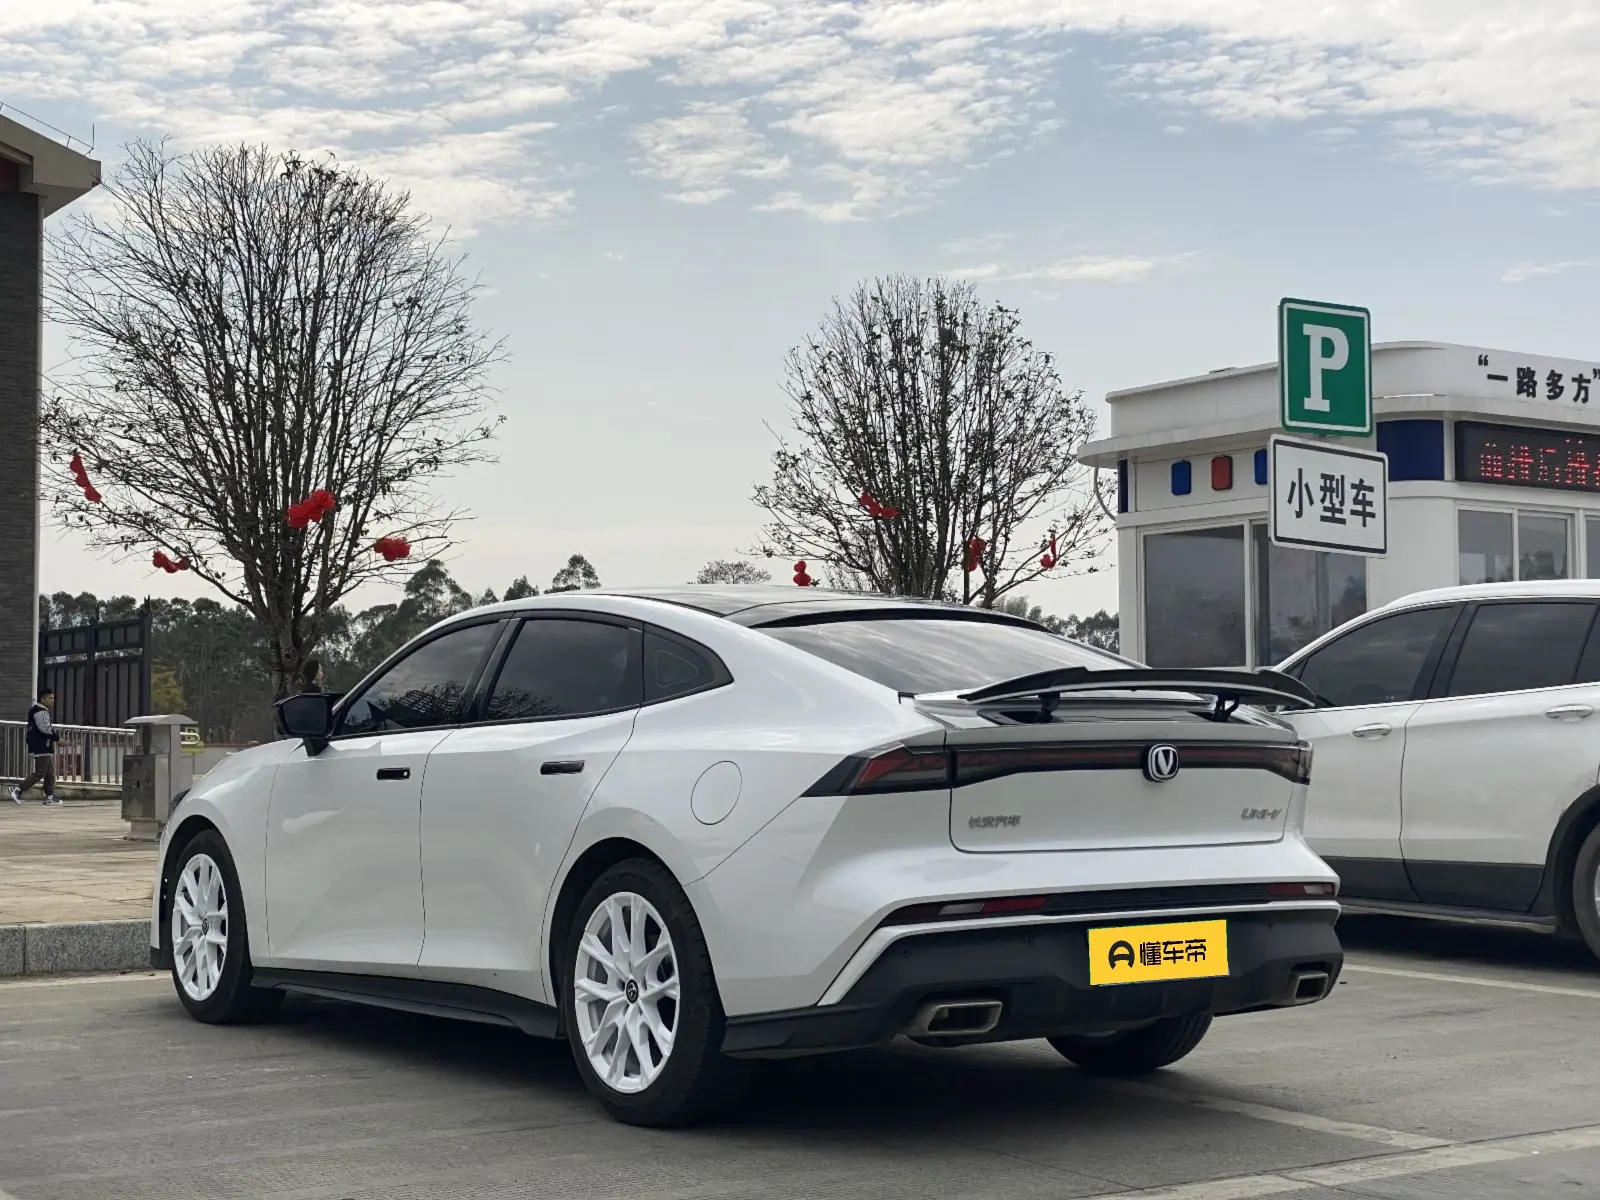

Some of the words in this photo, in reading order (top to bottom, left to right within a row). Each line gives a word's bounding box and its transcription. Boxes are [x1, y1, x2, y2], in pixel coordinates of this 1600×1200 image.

[1303, 323, 1349, 412] P
[1287, 467, 1376, 527] 小型车
